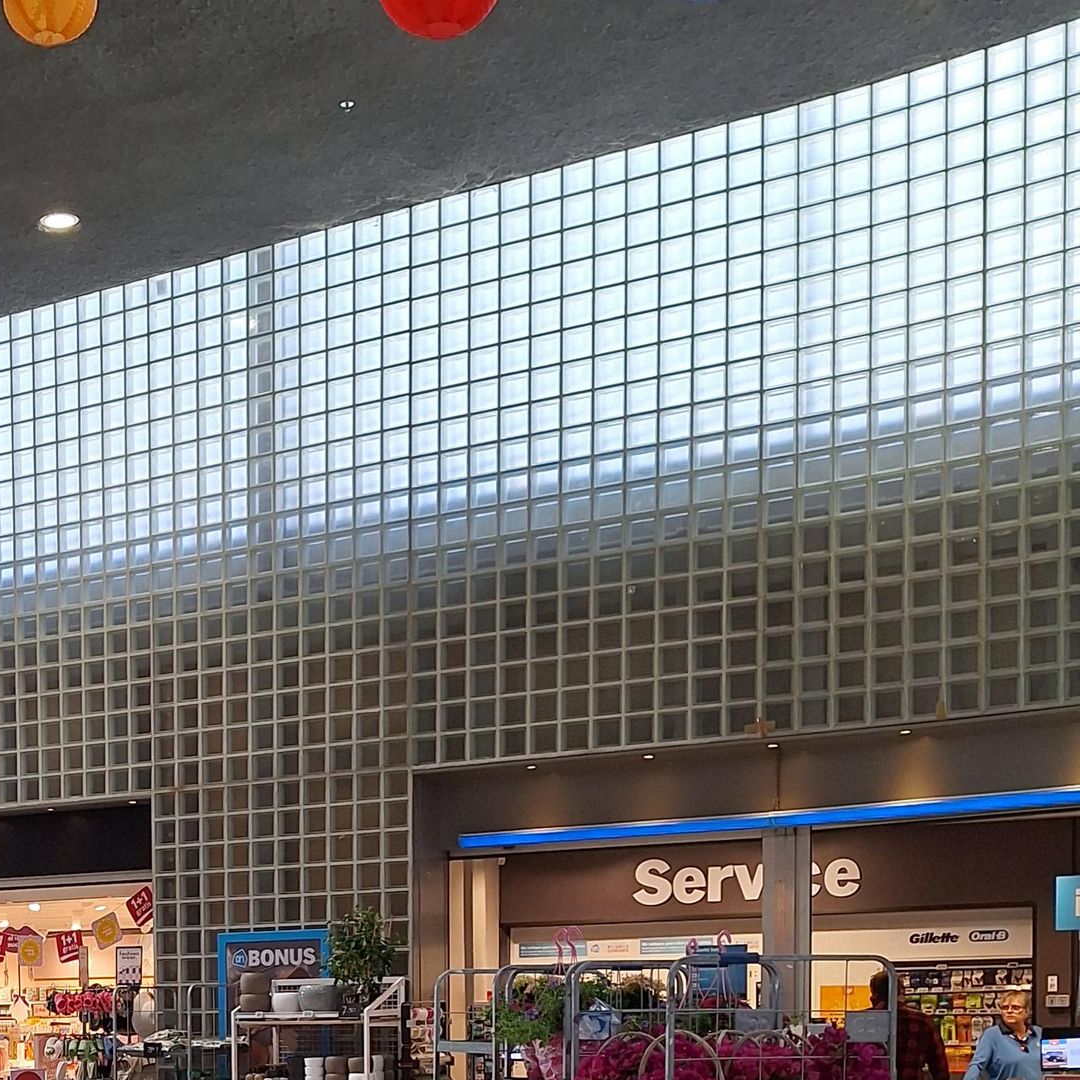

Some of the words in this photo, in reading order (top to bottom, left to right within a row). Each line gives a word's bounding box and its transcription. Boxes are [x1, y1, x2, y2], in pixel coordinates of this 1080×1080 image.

[632, 857, 861, 906] Serve
[131, 891, 149, 909] 1+1
[61, 932, 78, 945] 1+1
[909, 932, 959, 944] Gillette
[248, 947, 316, 968] BONUS
